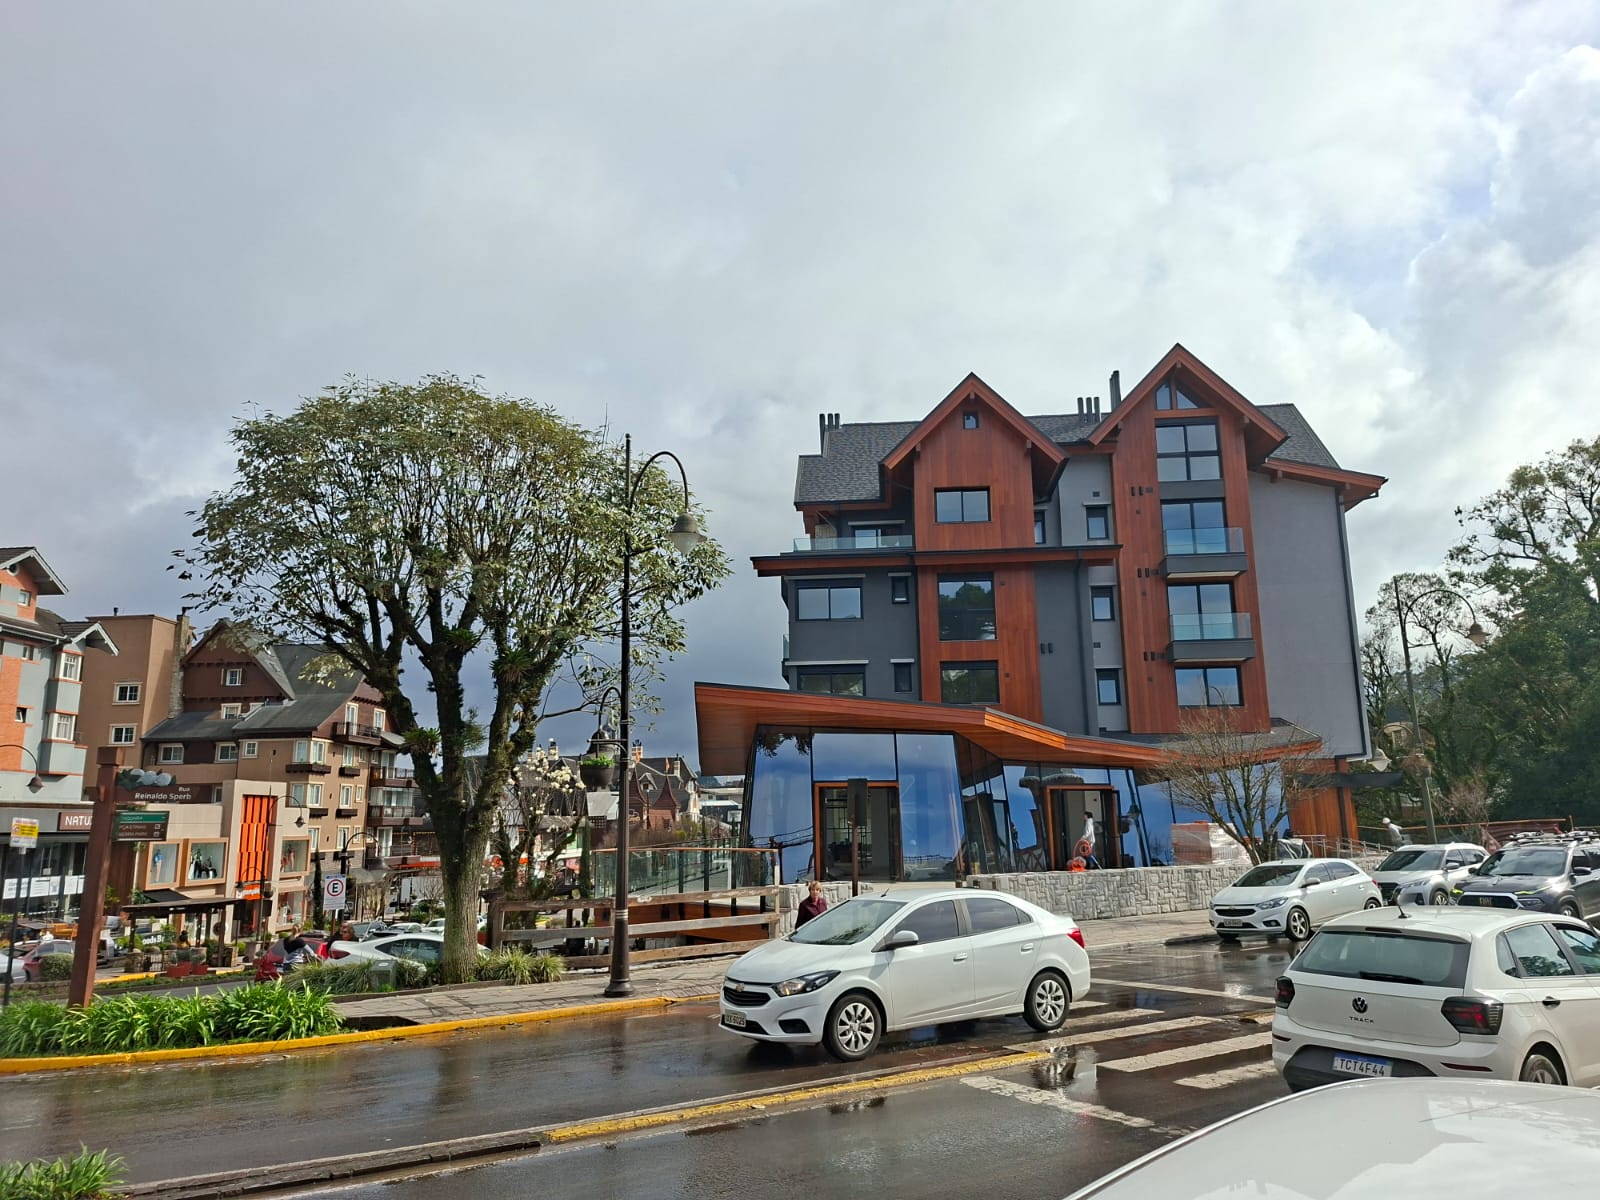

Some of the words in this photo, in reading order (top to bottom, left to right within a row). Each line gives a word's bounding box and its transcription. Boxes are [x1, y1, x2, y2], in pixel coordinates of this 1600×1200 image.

[134, 792, 168, 800] Reinaldo
[169, 793, 192, 801] Sperb
[65, 815, 93, 826] NATU
[332, 882, 340, 894] E
[1349, 1015, 1375, 1024] TRACK
[1340, 1058, 1385, 1077] TCT4F44
